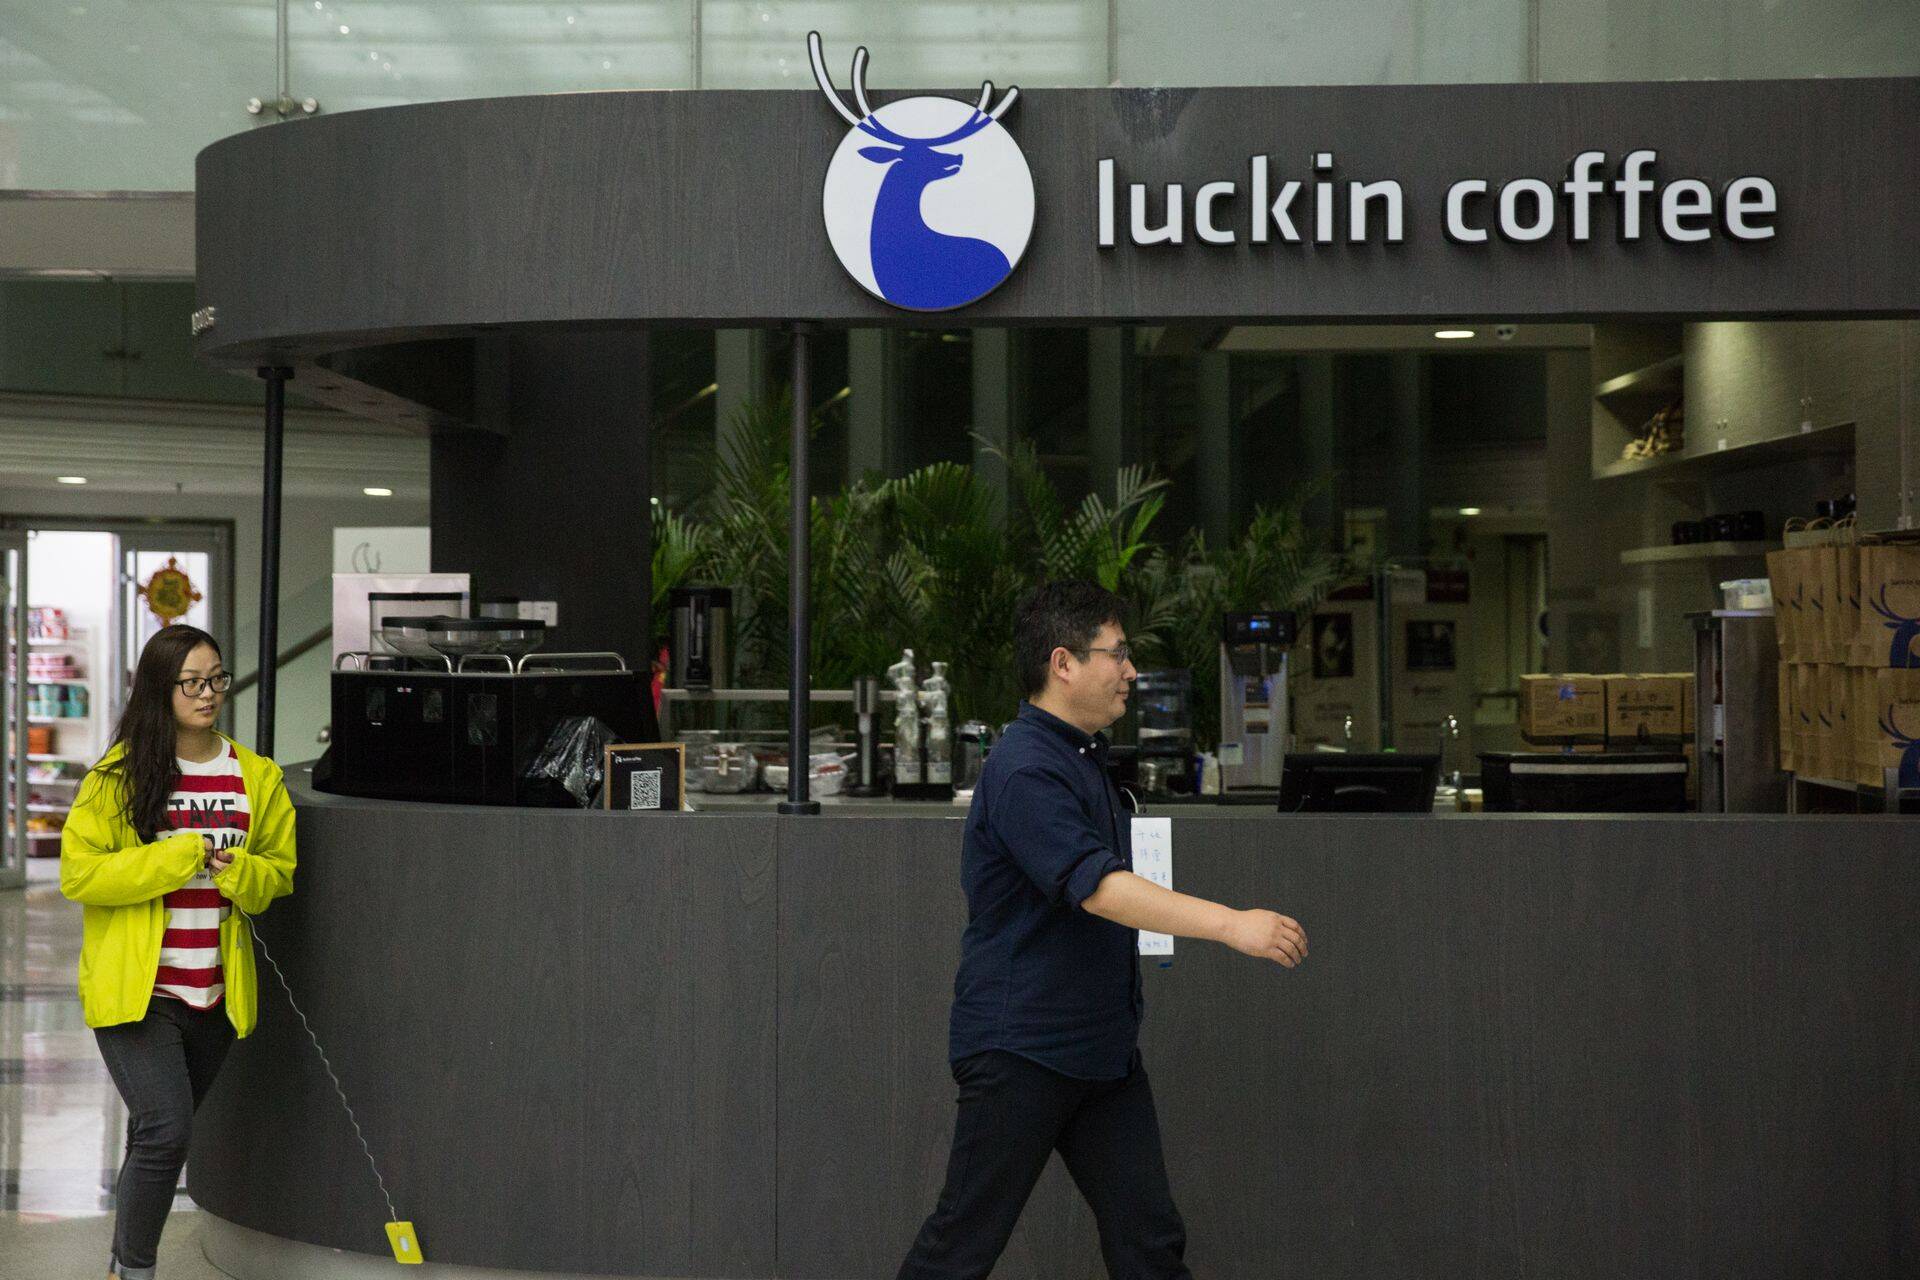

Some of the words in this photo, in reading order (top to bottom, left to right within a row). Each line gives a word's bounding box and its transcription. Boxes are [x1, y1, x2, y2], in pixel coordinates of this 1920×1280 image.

[1097, 152, 1404, 246] luckin
[1445, 149, 1778, 243] coffee
[168, 798, 239, 829] TAKE
